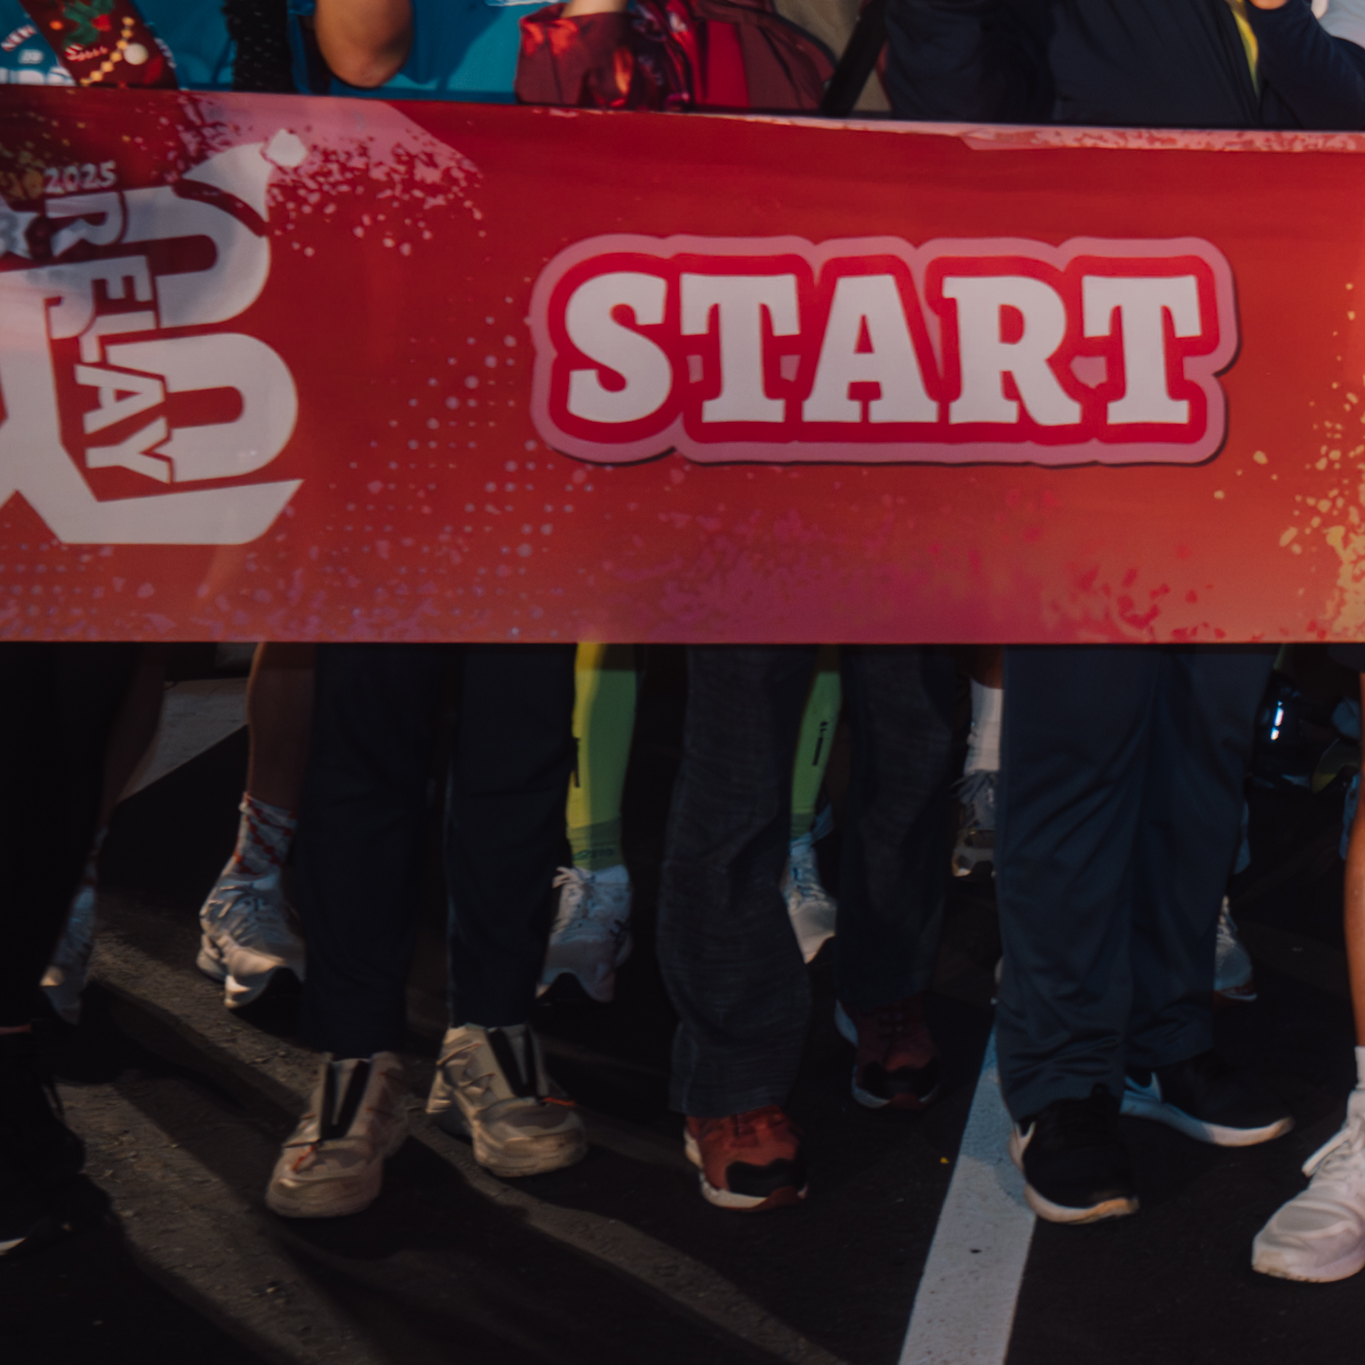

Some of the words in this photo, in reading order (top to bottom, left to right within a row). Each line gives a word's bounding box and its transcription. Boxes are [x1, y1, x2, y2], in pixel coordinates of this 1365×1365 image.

[44, 160, 118, 194] 2025
[45, 189, 173, 484] RELAY
[565, 271, 1202, 426] START
